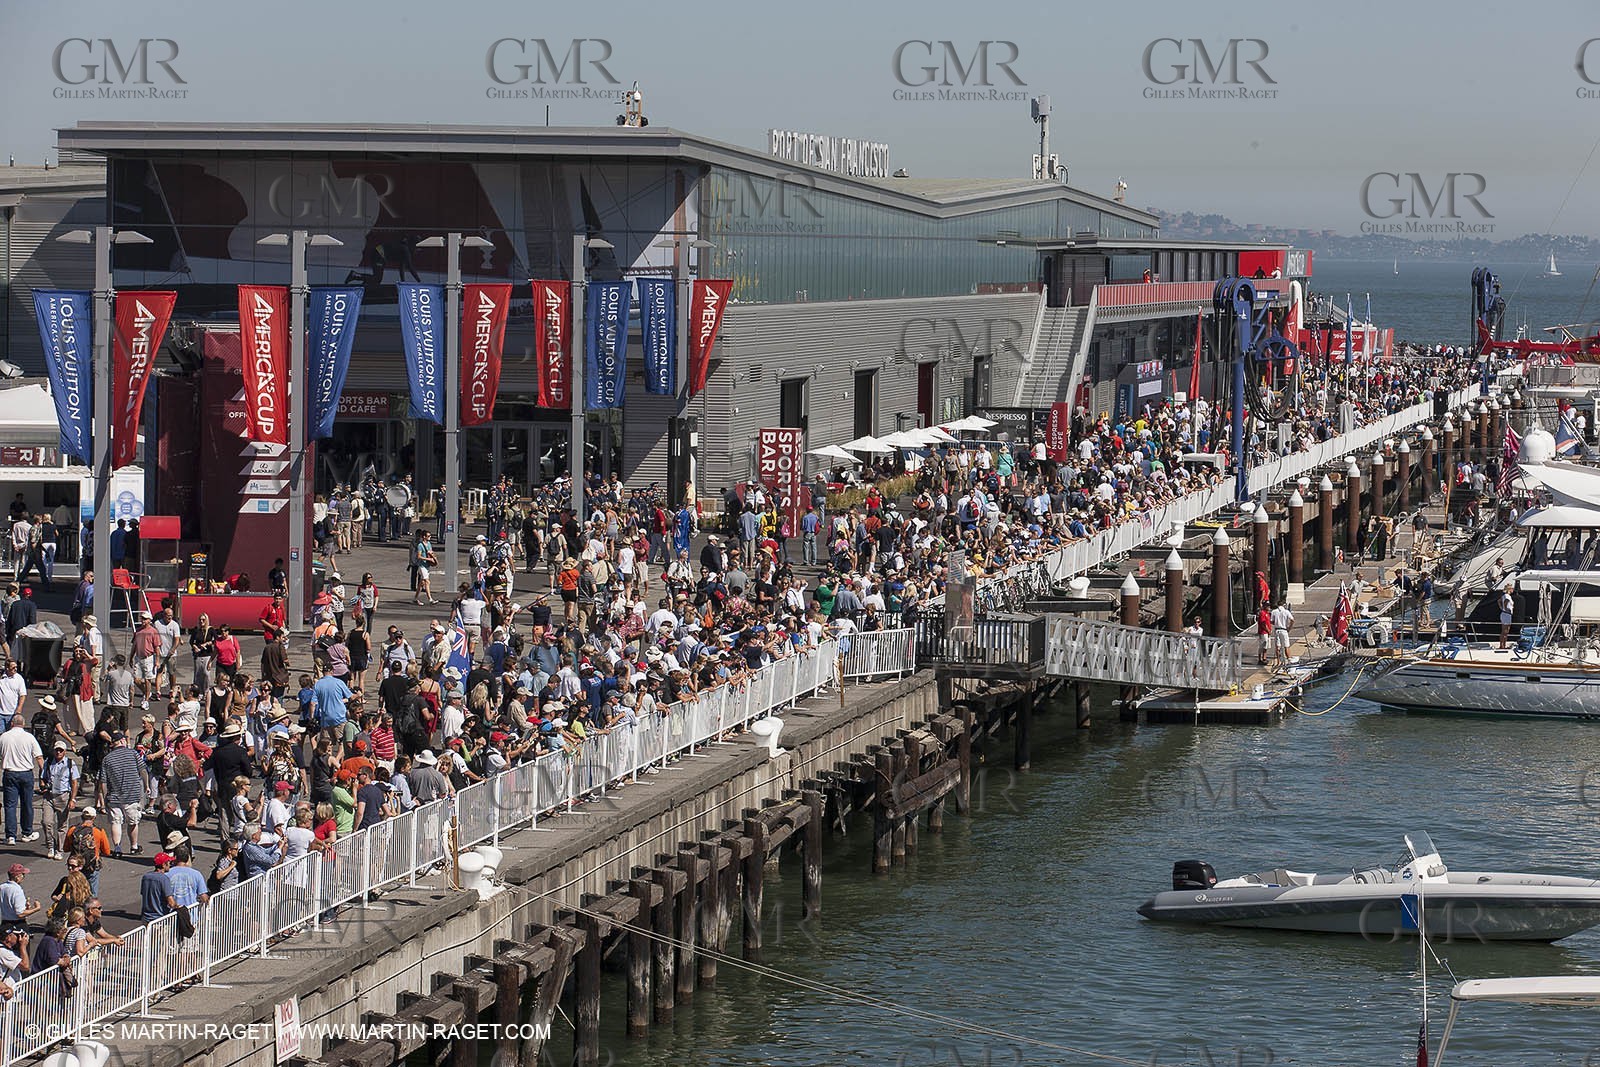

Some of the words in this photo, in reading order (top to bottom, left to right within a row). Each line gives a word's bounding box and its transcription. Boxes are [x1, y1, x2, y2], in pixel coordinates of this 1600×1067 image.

[771, 129, 798, 161] PORT
[802, 133, 814, 166] OF
[815, 136, 837, 172] SAN
[841, 138, 889, 178] FRANCISCO
[331, 294, 347, 336] LOUIS
[420, 288, 431, 326] LOUIS
[608, 286, 620, 320] LOUIS
[655, 283, 666, 314] LOUIS
[60, 298, 75, 344] LOUIS
[473, 290, 496, 380] AMERICA'S
[658, 318, 668, 365] VUITTON
[423, 330, 436, 386] VUITTON
[605, 325, 616, 376] VUITTON
[64, 350, 81, 420] VUITTON
[322, 342, 338, 402] VUITTON
[549, 368, 564, 402] CUP
[605, 380, 615, 403] CUP
[257, 393, 274, 435] CUP
[338, 396, 364, 404] ORTS
[366, 396, 388, 404] BAR
[350, 405, 376, 414] CAFE
[472, 380, 486, 418] CUP
[984, 412, 1027, 420] NESPRESSO
[762, 432, 776, 472] BAR
[778, 432, 793, 508] SPORTS
[281, 1000, 293, 1024] NO
